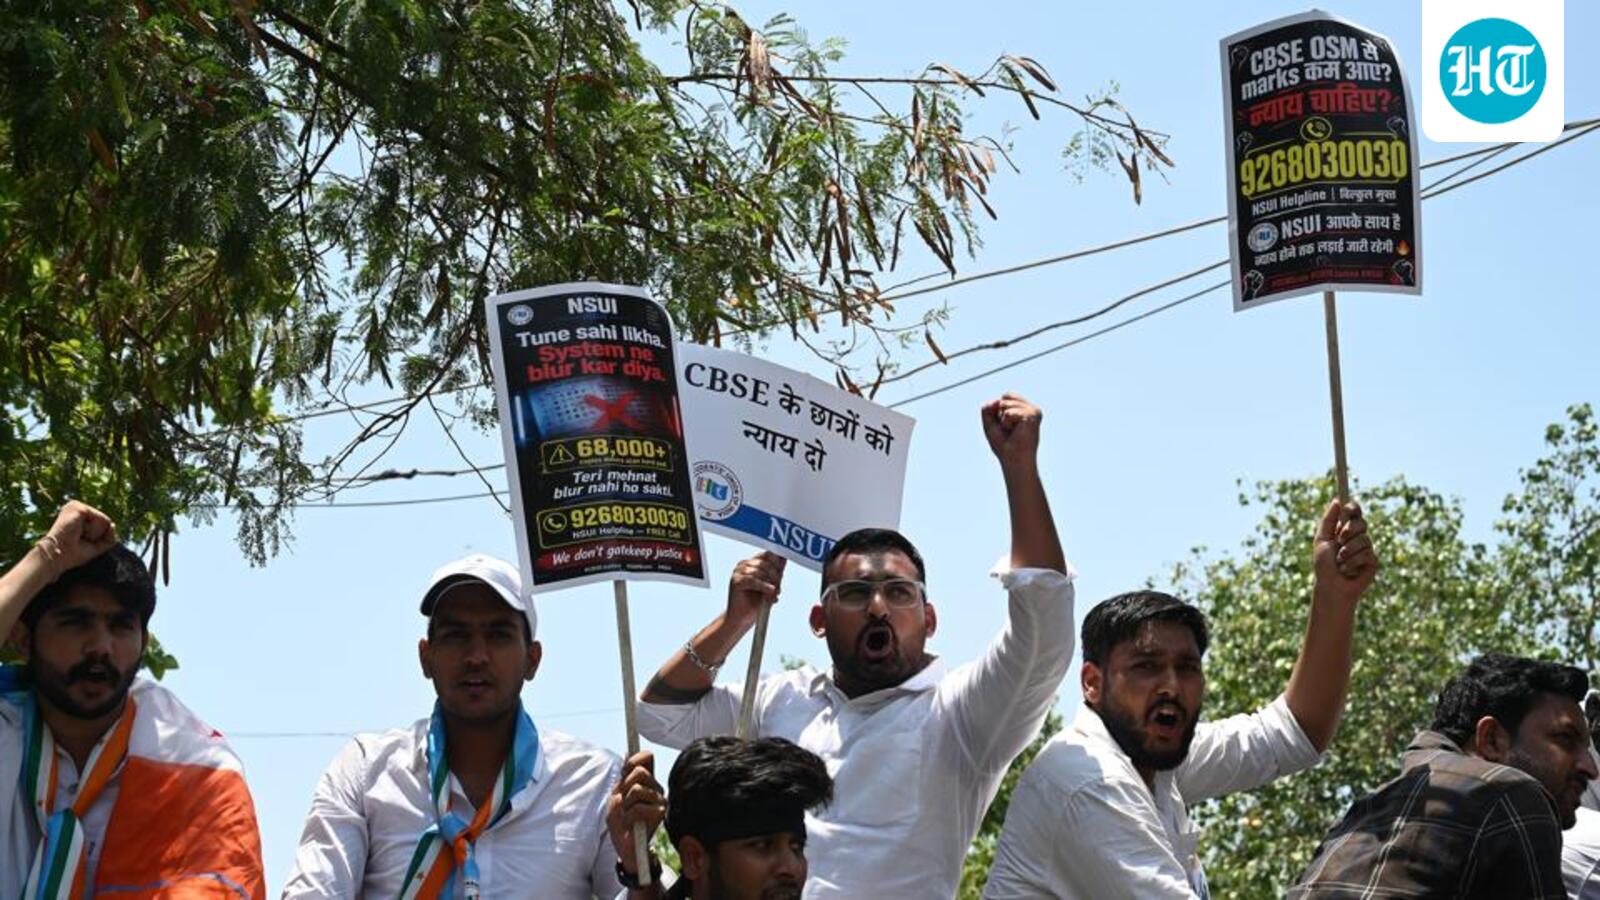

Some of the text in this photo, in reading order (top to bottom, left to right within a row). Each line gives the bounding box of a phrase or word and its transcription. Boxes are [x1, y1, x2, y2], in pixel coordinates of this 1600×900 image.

[1250, 35, 1380, 76] CBSE OSM से
[1241, 61, 1392, 100] marks कम आए?
[1248, 83, 1392, 126] न्याय चाहिए?
[1241, 140, 1407, 197] 9268030030
[1252, 200, 1278, 216] NSUI
[1280, 190, 1326, 208] Helpline
[1282, 214, 1321, 240] NSUI
[1326, 213, 1362, 232] आपके
[1364, 216, 1390, 230] साथ
[1392, 213, 1401, 231] है
[1346, 240, 1369, 253] जारी
[1370, 239, 1394, 254] रहेगी
[568, 297, 618, 314] NSUI
[515, 324, 666, 348] Tune sahi likha.
[536, 342, 655, 364] System ne
[526, 359, 666, 382] blur kar diya.
[684, 362, 894, 456] CBSE के छात्रों को
[577, 438, 666, 458] 68,000+
[742, 420, 827, 472] न्याय दो
[573, 469, 657, 484] Teri mehnat
[553, 481, 673, 500] blur nahi ho sakti.
[571, 505, 686, 529] 9268030030
[572, 528, 596, 539] NSUI
[600, 527, 634, 538] Helpline
[769, 516, 836, 560] NSU
[552, 545, 682, 566] We don't gatekeep justice
